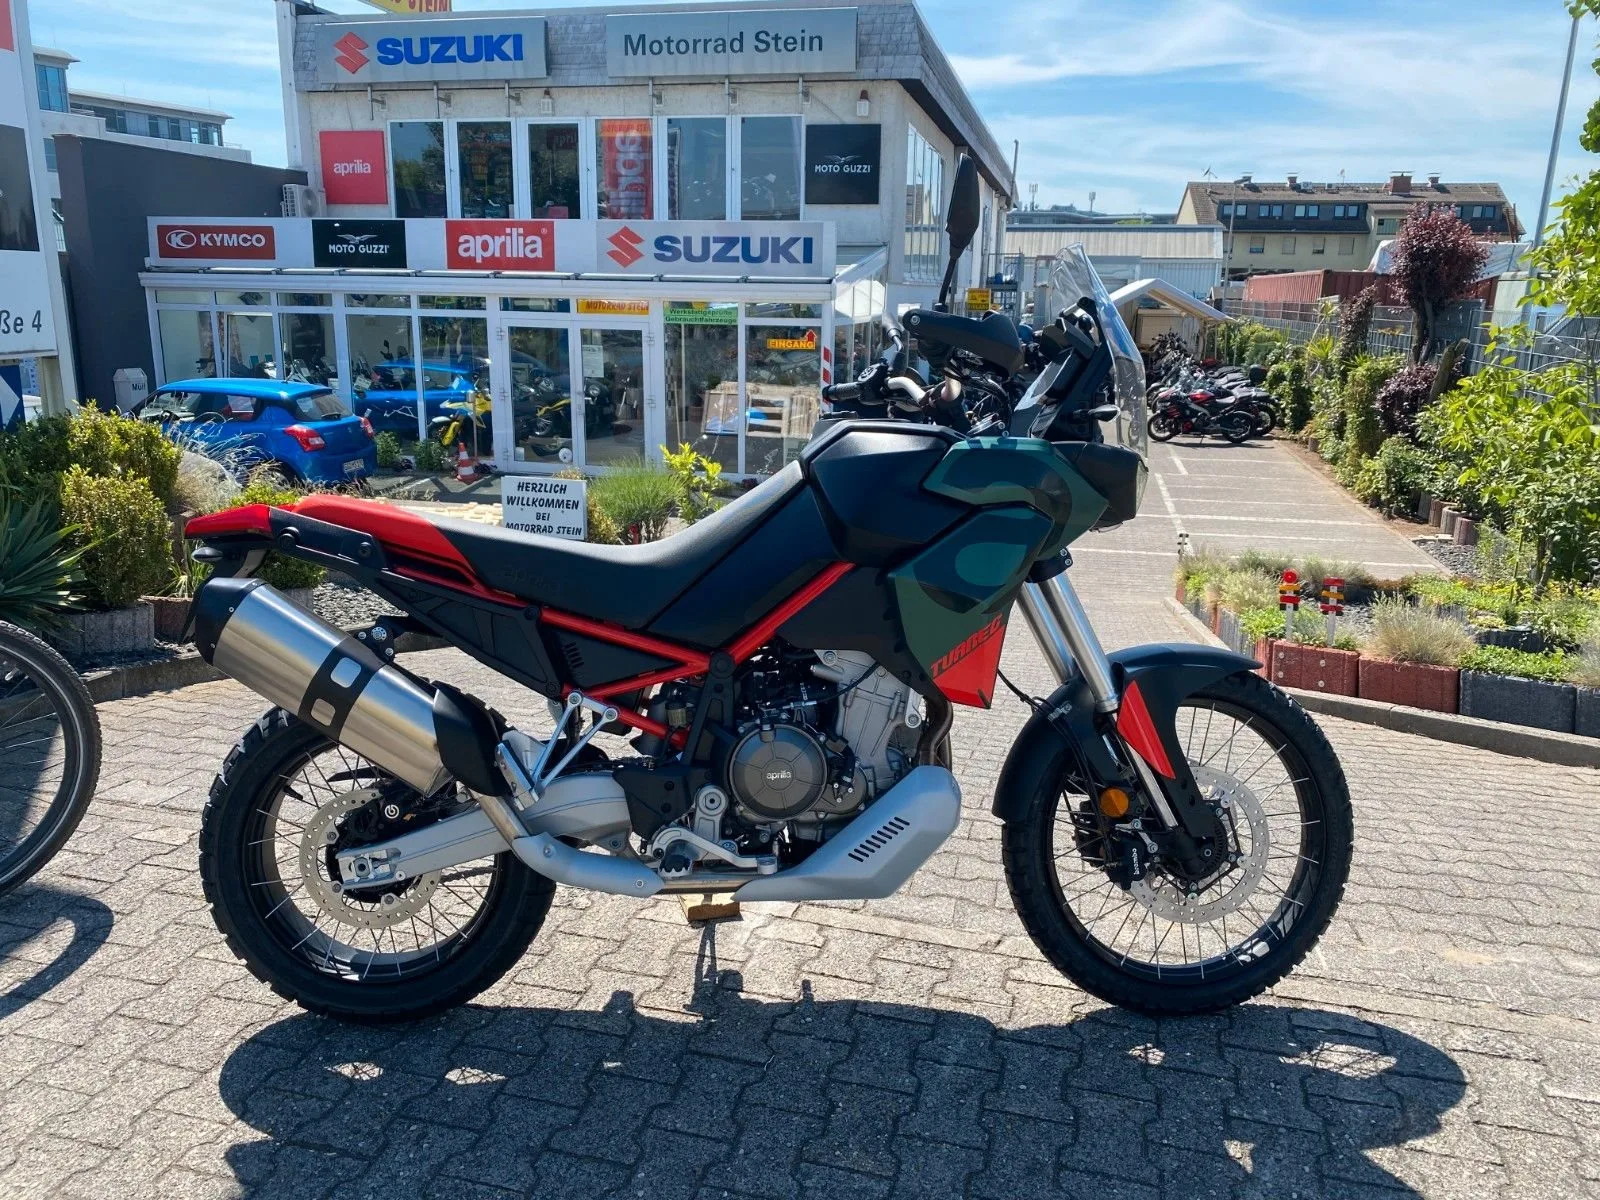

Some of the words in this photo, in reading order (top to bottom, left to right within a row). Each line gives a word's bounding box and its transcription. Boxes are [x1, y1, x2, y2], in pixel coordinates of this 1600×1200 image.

[376, 33, 524, 66] SUZUKI
[624, 31, 744, 56] Motorrad
[753, 29, 823, 53] Stein
[333, 159, 371, 176] aprilia
[815, 164, 840, 173] MOTO
[843, 164, 871, 173] GUZZI
[200, 233, 266, 247] KYMCO
[457, 227, 543, 263] aprilia
[328, 244, 356, 254] MOTO
[358, 244, 388, 254] GUZZI
[653, 235, 814, 264] SUZUKI
[586, 300, 626, 311] MOTORRAD
[31, 310, 42, 333] 4
[769, 340, 814, 348] EINGANG
[517, 482, 567, 494] HERZLICH
[506, 496, 579, 510] WILLKOMMEN
[536, 512, 550, 521] BEI
[505, 522, 553, 534] MOTORRAD
[556, 526, 582, 535] STEIN
[766, 769, 792, 781] aprilia
[1132, 848, 1140, 875] brembo
